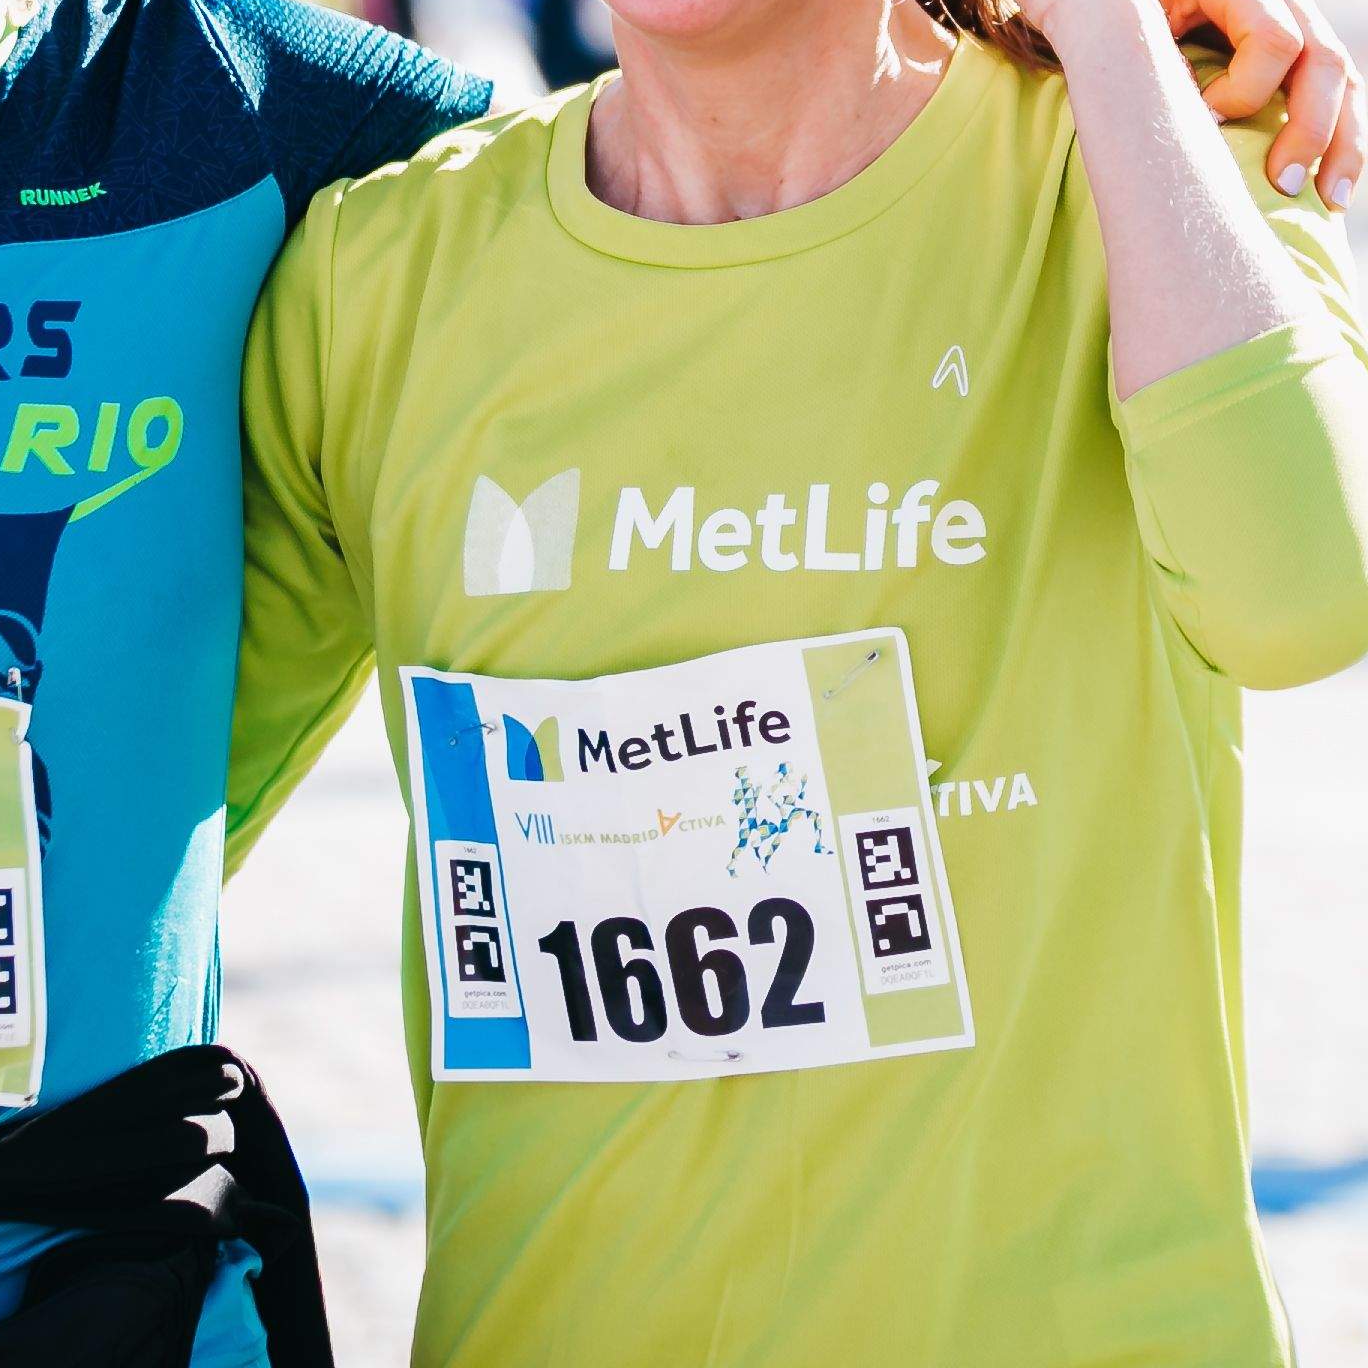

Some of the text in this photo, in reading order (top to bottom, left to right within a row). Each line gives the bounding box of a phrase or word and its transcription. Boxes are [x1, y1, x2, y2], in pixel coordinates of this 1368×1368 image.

[20, 182, 107, 206] RUNNEK
[0, 395, 185, 475] RIO
[608, 480, 988, 572] MetLife
[577, 699, 793, 774] MetLife
[515, 812, 556, 845] VIII
[600, 829, 659, 845] MADRID
[538, 897, 825, 1043] 1662
